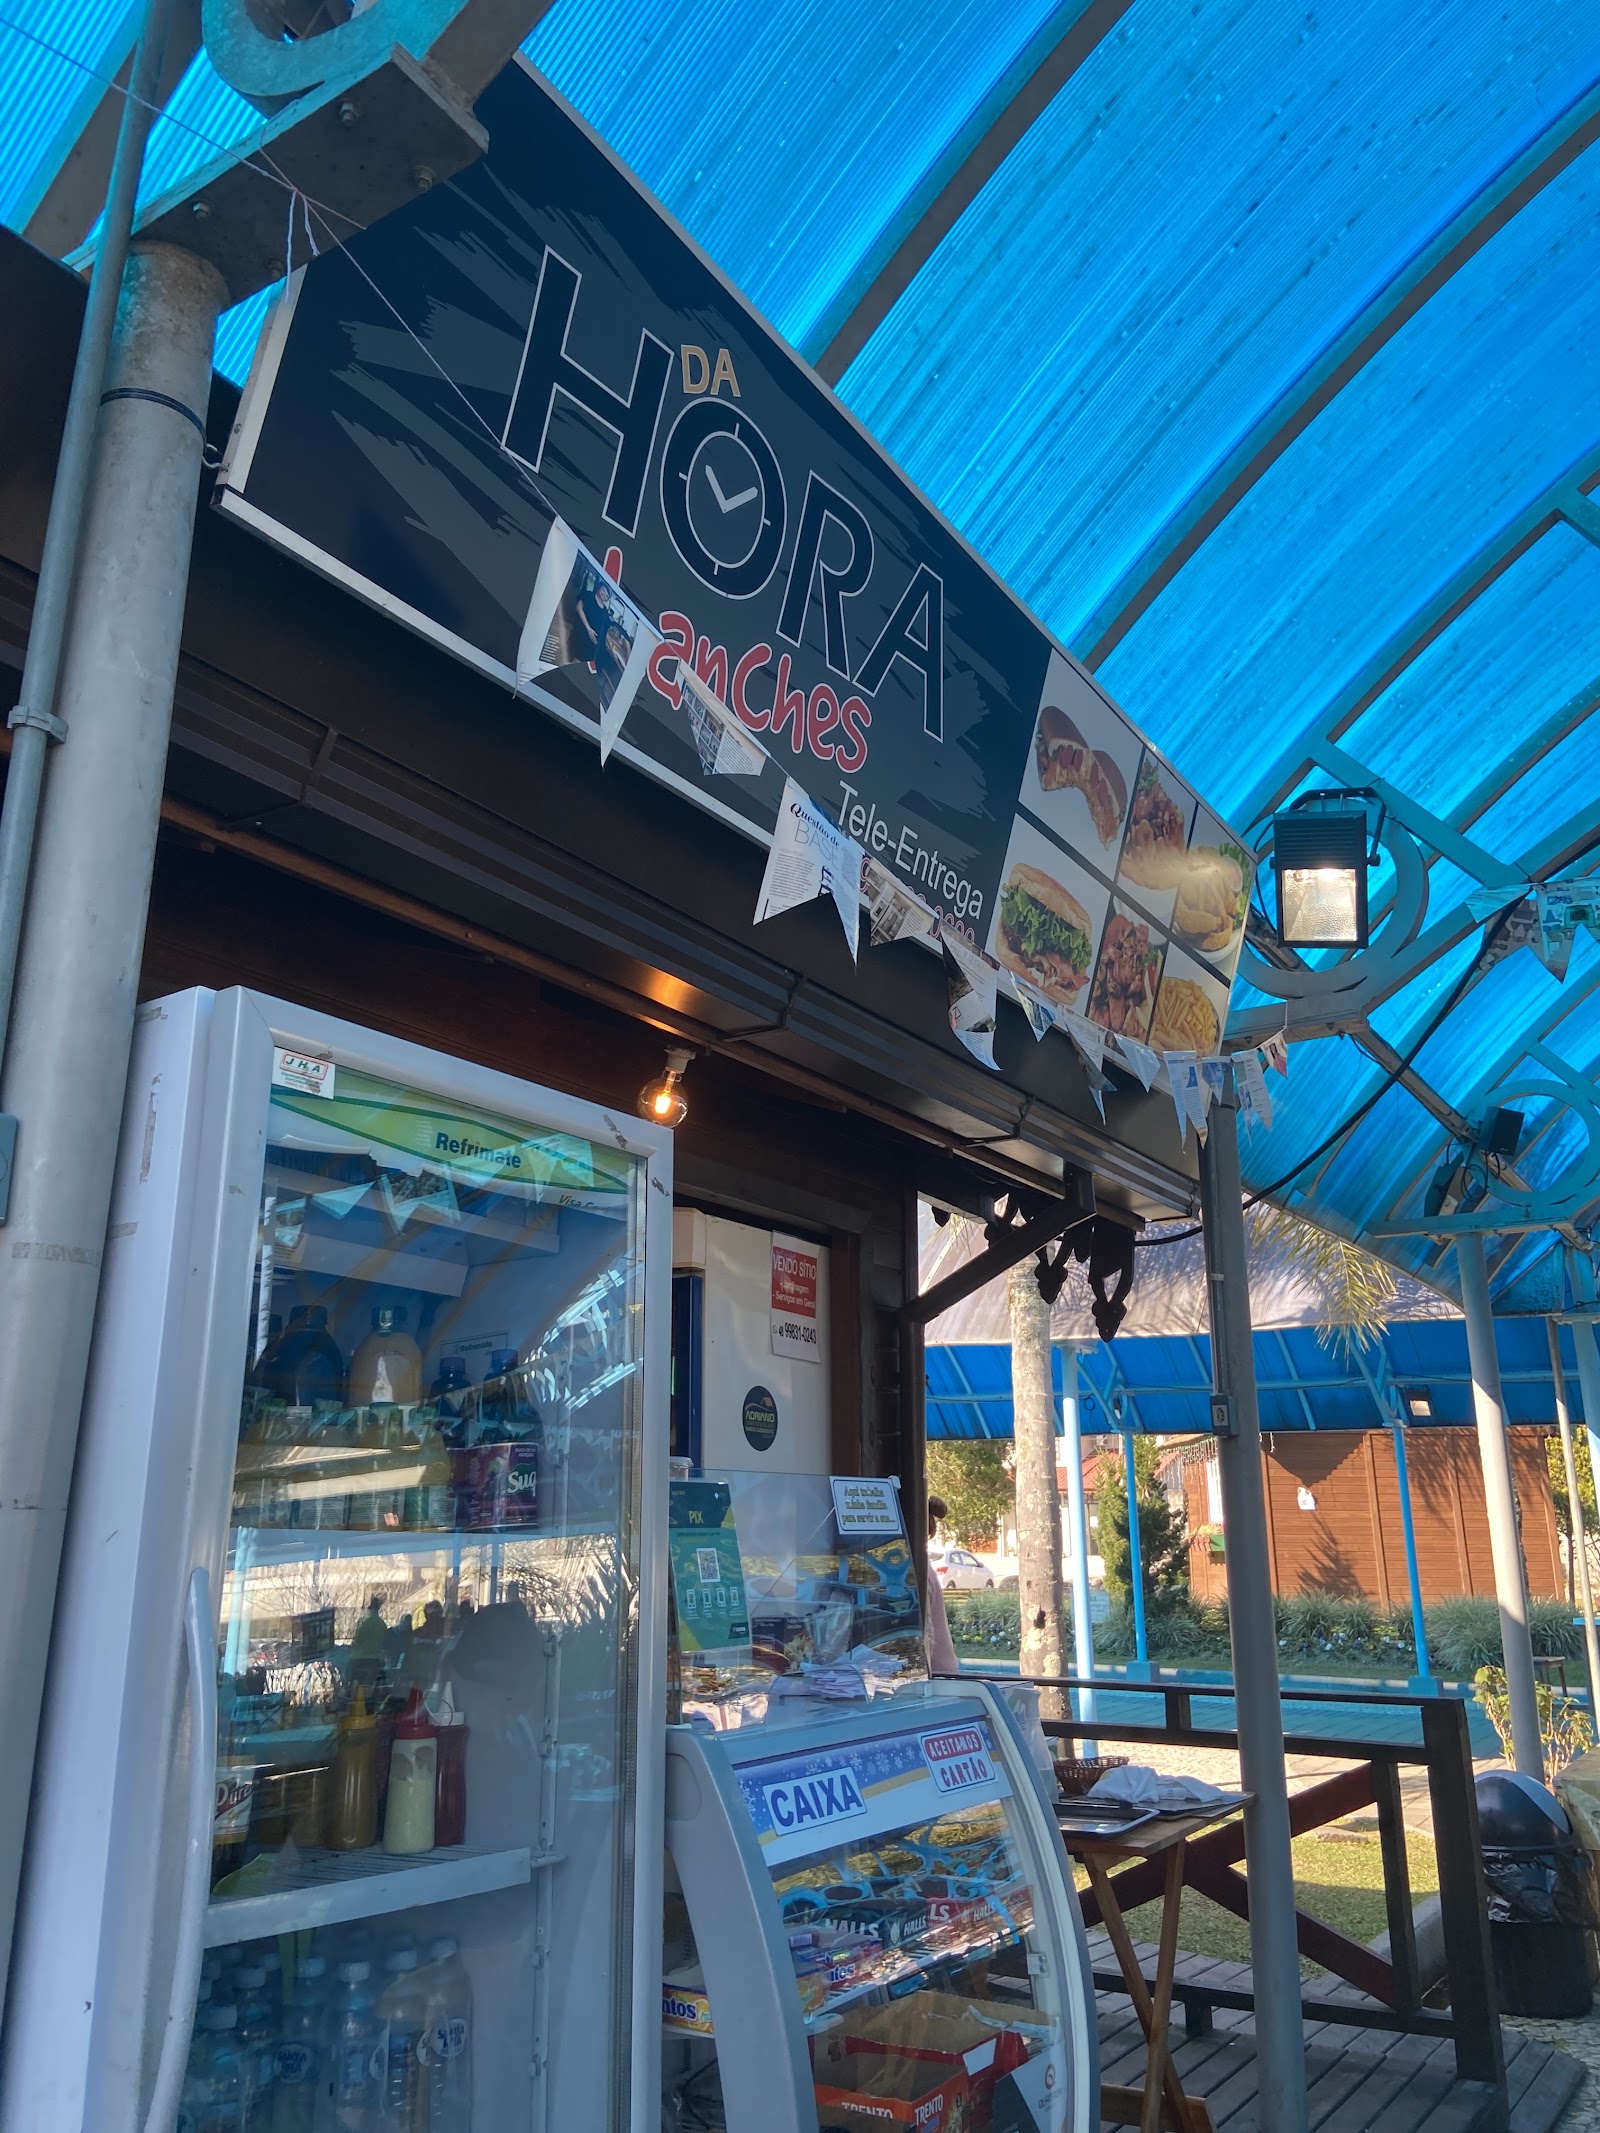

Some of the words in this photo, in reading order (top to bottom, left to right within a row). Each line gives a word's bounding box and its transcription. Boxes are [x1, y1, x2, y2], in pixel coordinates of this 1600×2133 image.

[680, 343, 742, 398] DA
[500, 244, 944, 743] HORA
[794, 819, 839, 870] BASE
[838, 780, 984, 920] Tele-Entrega
[435, 1132, 521, 1168] Refrimate
[772, 1254, 798, 1275] VENDO
[799, 1259, 817, 1280] SÍTIO
[688, 1510, 704, 1524] PIX
[929, 1732, 979, 1758] ACEITAMOS
[940, 1757, 988, 1788] CARTÃO
[770, 1774, 863, 1827] CAIXA
[903, 1915, 927, 1937] HALLS
[914, 2093, 944, 2125] TRENTO
